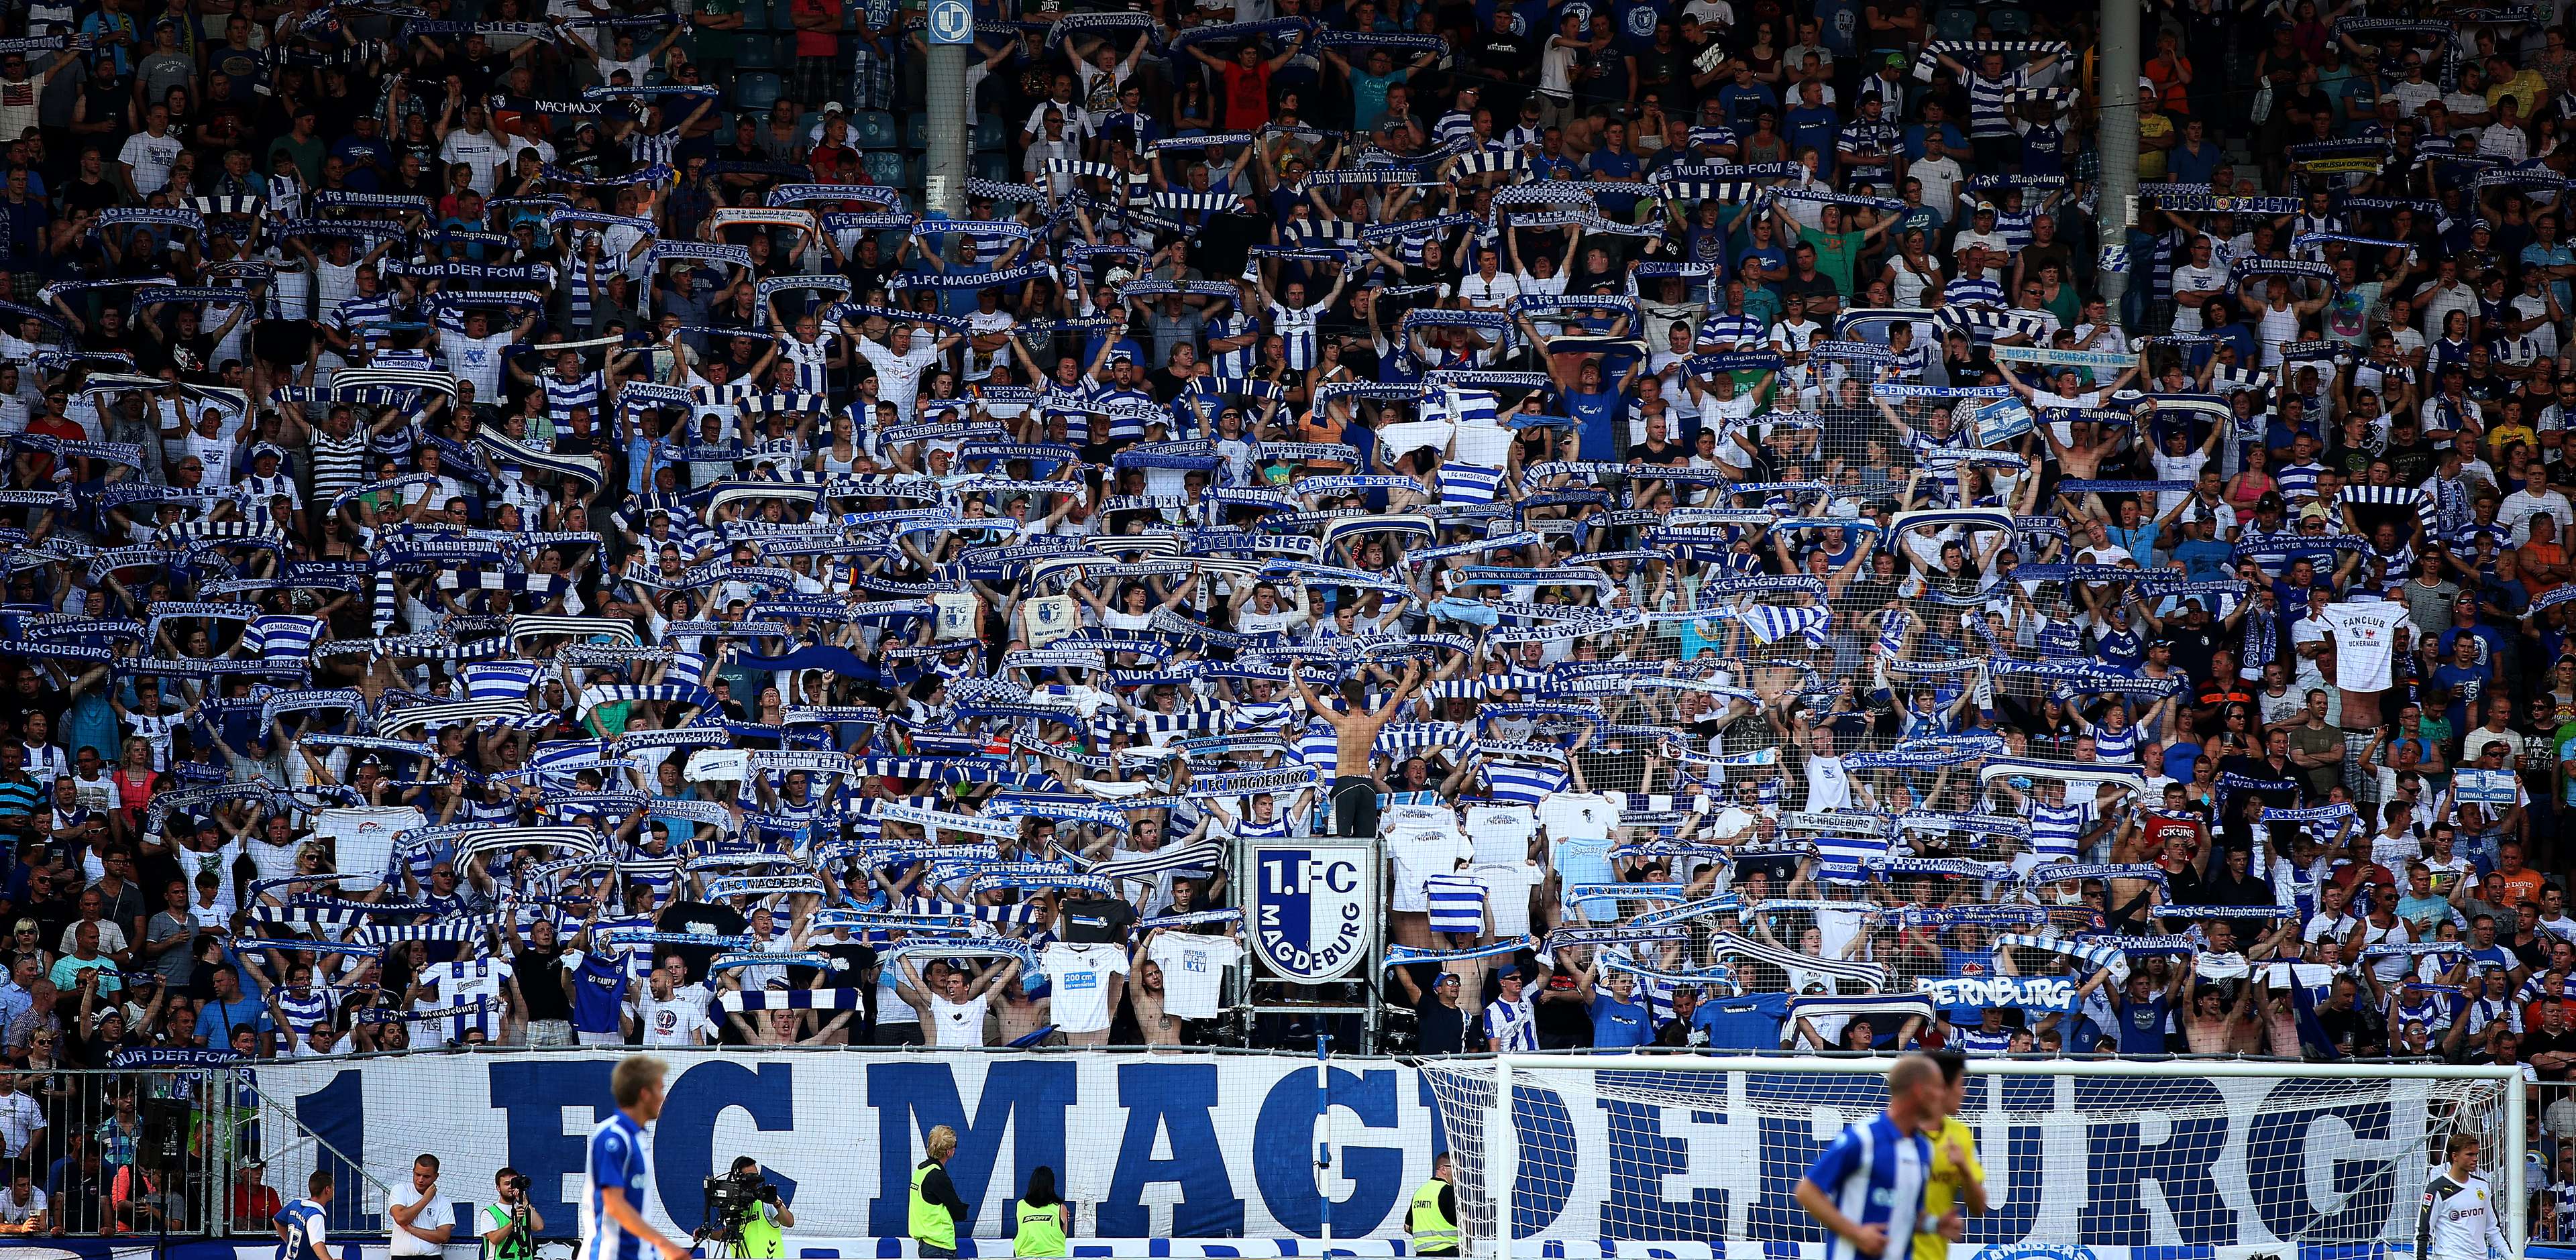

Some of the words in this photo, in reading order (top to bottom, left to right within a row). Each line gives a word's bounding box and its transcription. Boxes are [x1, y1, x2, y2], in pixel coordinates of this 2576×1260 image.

[535, 99, 602, 115] NACHWUX
[1677, 165, 1709, 176] NUR
[1713, 164, 1744, 176] DER
[1748, 163, 1781, 174] FCM
[1300, 175, 1311, 187] DU
[1316, 172, 1334, 184] BIST
[1339, 171, 1377, 184] NIEMALS
[1381, 170, 1417, 184] ALLEINE
[2008, 173, 2065, 186] Magdeburg
[2252, 196, 2299, 213] FCM
[851, 215, 911, 227] MAGDEBURG
[932, 222, 947, 232] FC
[950, 222, 1021, 235] MAGDEBURG
[409, 266, 444, 276] NUR
[449, 264, 482, 276] DER
[486, 266, 525, 278] FCM
[2243, 261, 2259, 270] FC
[943, 268, 1028, 286] MAGDEBURG
[1537, 296, 1554, 305] FC
[1050, 397, 1099, 410] BLAU
[1106, 406, 1160, 420] WEISS
[890, 422, 964, 441] MAGDEBURGER
[980, 446, 995, 455] FC
[998, 447, 1072, 458] MAGDEBURG
[1263, 446, 1328, 456] AUFSTEIGER
[1307, 477, 1358, 488] EINMAL
[1364, 477, 1409, 487] IMMER
[828, 487, 876, 497] BLAU
[882, 487, 936, 501] WEISS
[873, 506, 951, 520] MAGDEBURG
[1649, 525, 1666, 536] FC
[391, 542, 402, 553] 1.
[404, 542, 421, 552] FC
[423, 541, 499, 554] MAGDEBURG
[769, 541, 845, 553] MAGDEBURGER
[2273, 542, 2302, 550] NEVER
[2307, 541, 2332, 549] WALK
[115, 553, 148, 567] LIEBT
[1115, 564, 1192, 573] MAGDEBURG
[870, 576, 890, 587] FC
[1468, 571, 1496, 579] HUTNIK
[1555, 572, 1599, 581] MAGDEBURG
[2100, 573, 2128, 581] NEVER
[1716, 580, 1733, 592] FC
[1734, 578, 1823, 594] MAGDEBURG
[2170, 578, 2248, 591] MAGDEBURG
[1536, 610, 1593, 623] WEISS
[2343, 616, 2386, 628] FANCLUB
[52, 622, 146, 638] MAGDEBURG
[1505, 627, 1553, 641] BLAU
[1558, 622, 1614, 636] WEISS
[16, 640, 112, 659] MAGDEBURG
[121, 658, 138, 669] FC
[1212, 661, 1240, 673] 1.FC
[1117, 670, 1155, 681] NUR
[1159, 669, 1194, 680] DER
[1552, 681, 1568, 692] FC
[2090, 679, 2108, 687] FC
[702, 717, 718, 726] FC
[1016, 736, 1069, 760] BLAU
[1880, 754, 1898, 762] FC
[1196, 779, 1207, 792] 1.
[1208, 778, 1224, 792] FC
[1226, 770, 1309, 791] MAGDEBURG
[1817, 816, 1870, 827] MAGDEBURG
[747, 878, 823, 890] MAGDEBURG
[2213, 905, 2276, 917] Magdeburg
[1260, 902, 1360, 971] MAGDEBURG
[747, 952, 807, 960] MAGDEBURG
[1184, 956, 1206, 964] MCM
[1183, 964, 1207, 973] LXV
[1065, 972, 1081, 982] 200
[1919, 977, 2076, 1010] BERNBURG
[419, 1002, 480, 1019] Magdeburg
[113, 1050, 147, 1068] NUR
[152, 1049, 190, 1063] DER
[490, 1059, 798, 1239] FC
[1024, 1215, 1051, 1223] SPORT
